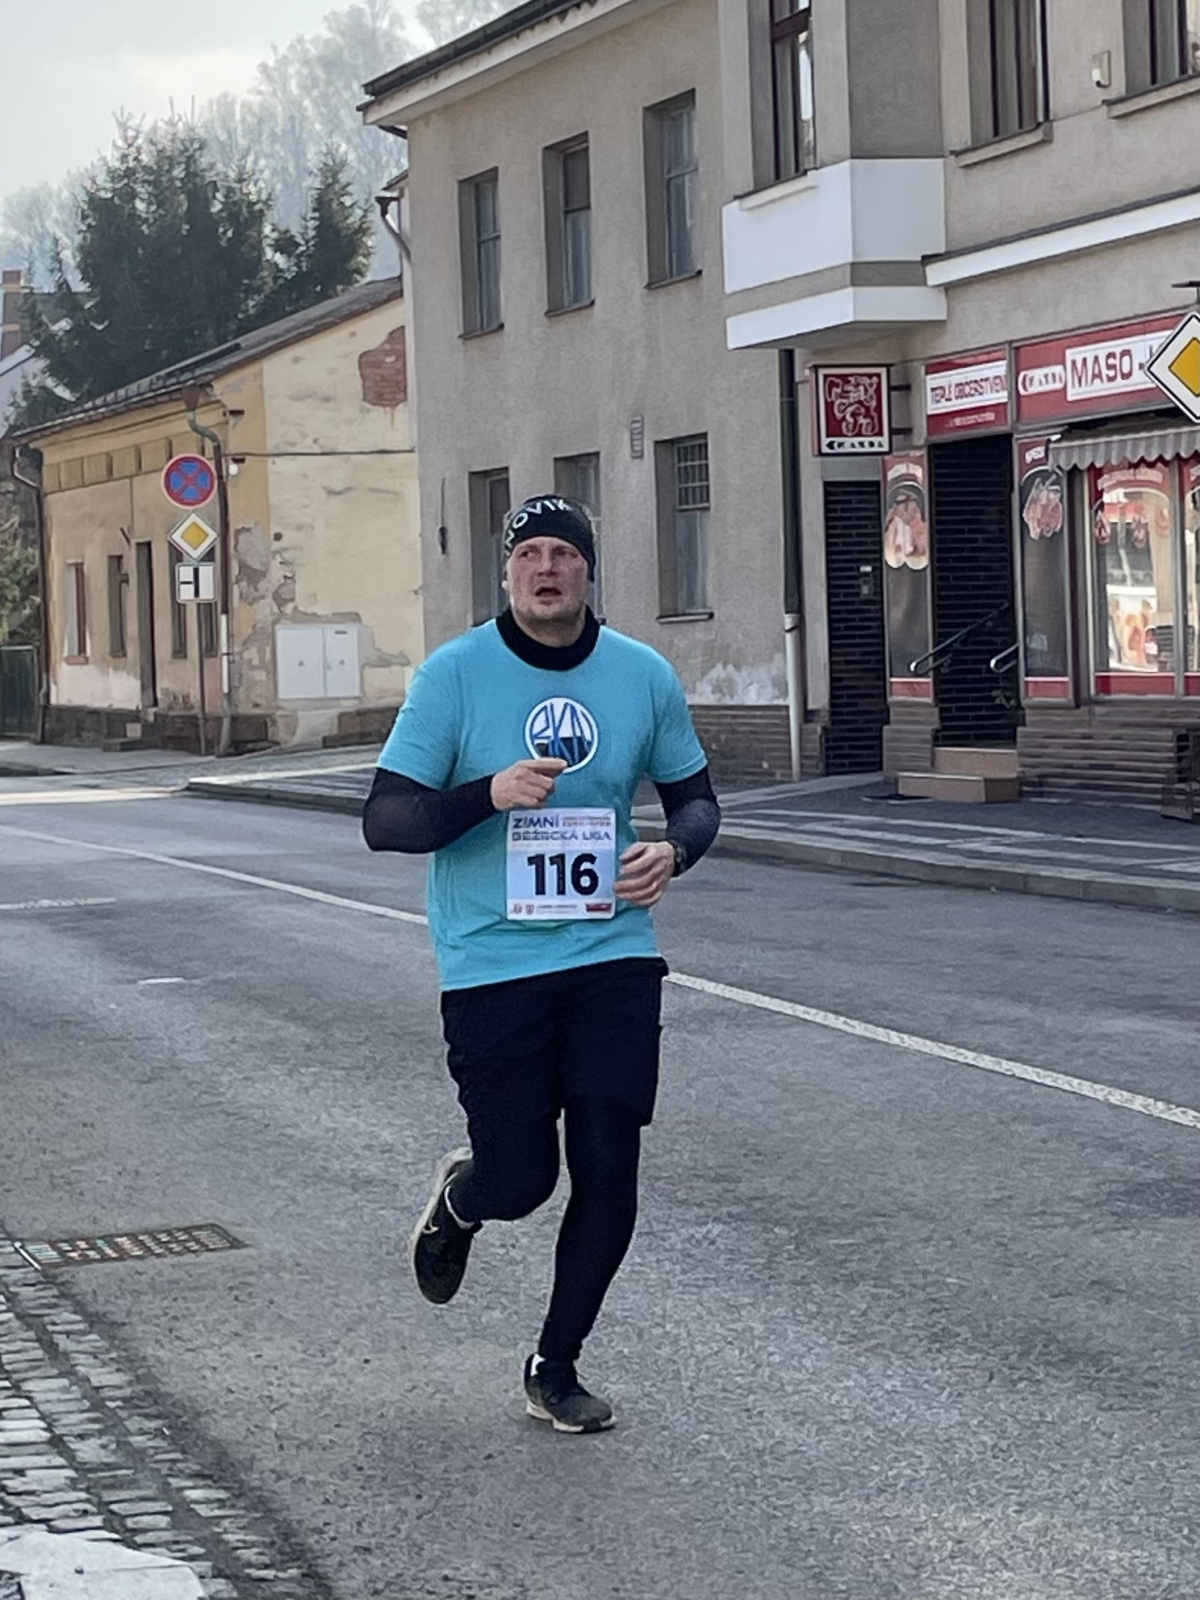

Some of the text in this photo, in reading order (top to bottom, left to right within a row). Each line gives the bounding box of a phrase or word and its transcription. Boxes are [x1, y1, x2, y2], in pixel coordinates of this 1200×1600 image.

[1071, 349, 1134, 389] MASO
[513, 814, 560, 829] ZIMNÍ
[582, 831, 612, 841] LIGA
[526, 852, 600, 896] 116
